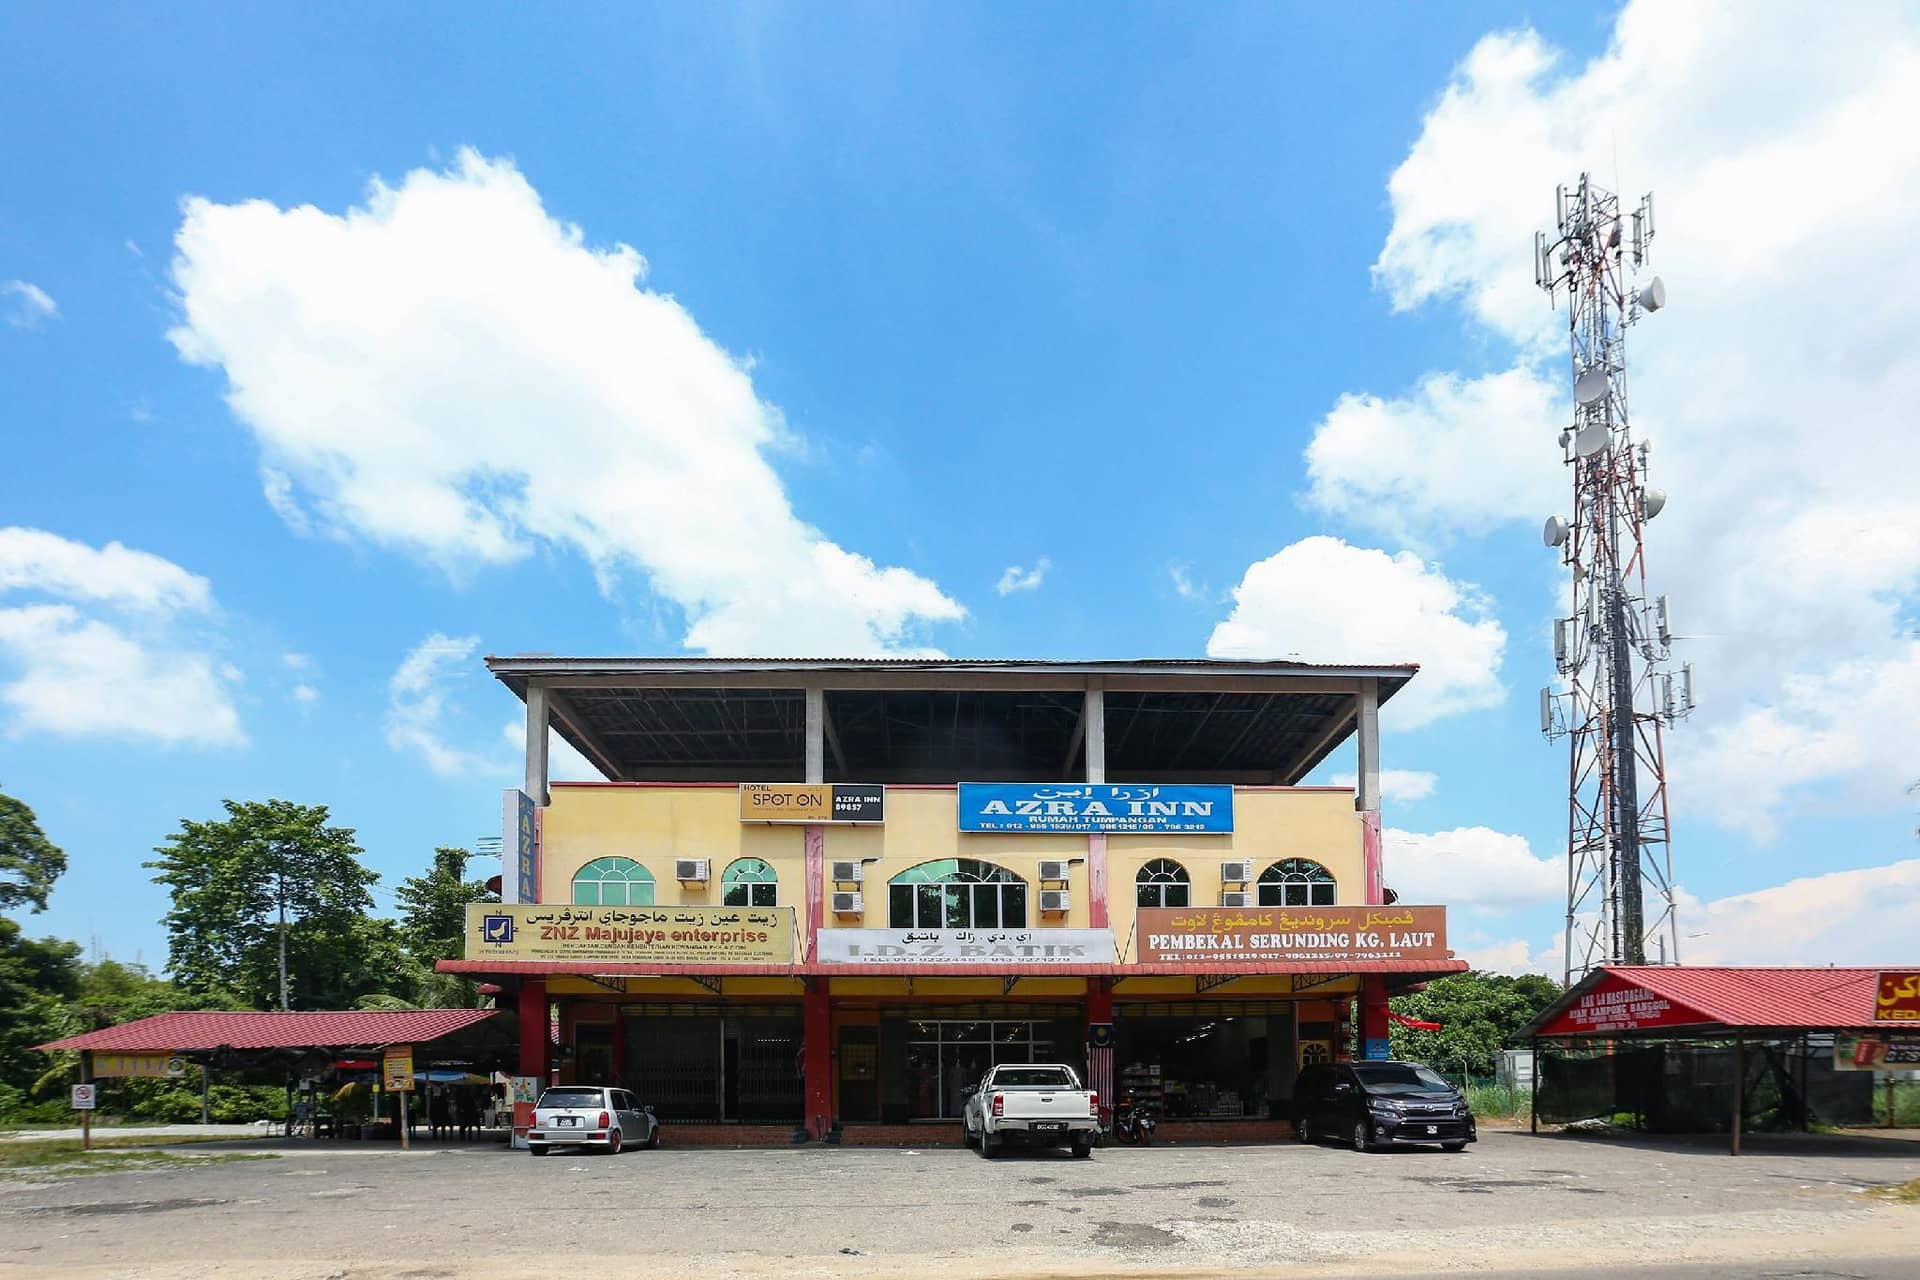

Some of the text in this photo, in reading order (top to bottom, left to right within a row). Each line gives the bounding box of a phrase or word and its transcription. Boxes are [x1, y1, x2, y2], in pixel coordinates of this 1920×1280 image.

[753, 794, 822, 806] SPOT ON
[980, 800, 1214, 816] AZRA INN
[521, 814, 531, 897] AZRA
[674, 912, 704, 926] زيت
[710, 913, 740, 926] عين
[747, 913, 777, 927] زيت
[541, 926, 768, 944] ZNZ Majujaya enterprise
[1149, 932, 1435, 950] PEMBEKAL SERUNDING KG. LAUT
[960, 945, 1087, 957] BATIK
[1876, 1009, 1920, 1019] KED
